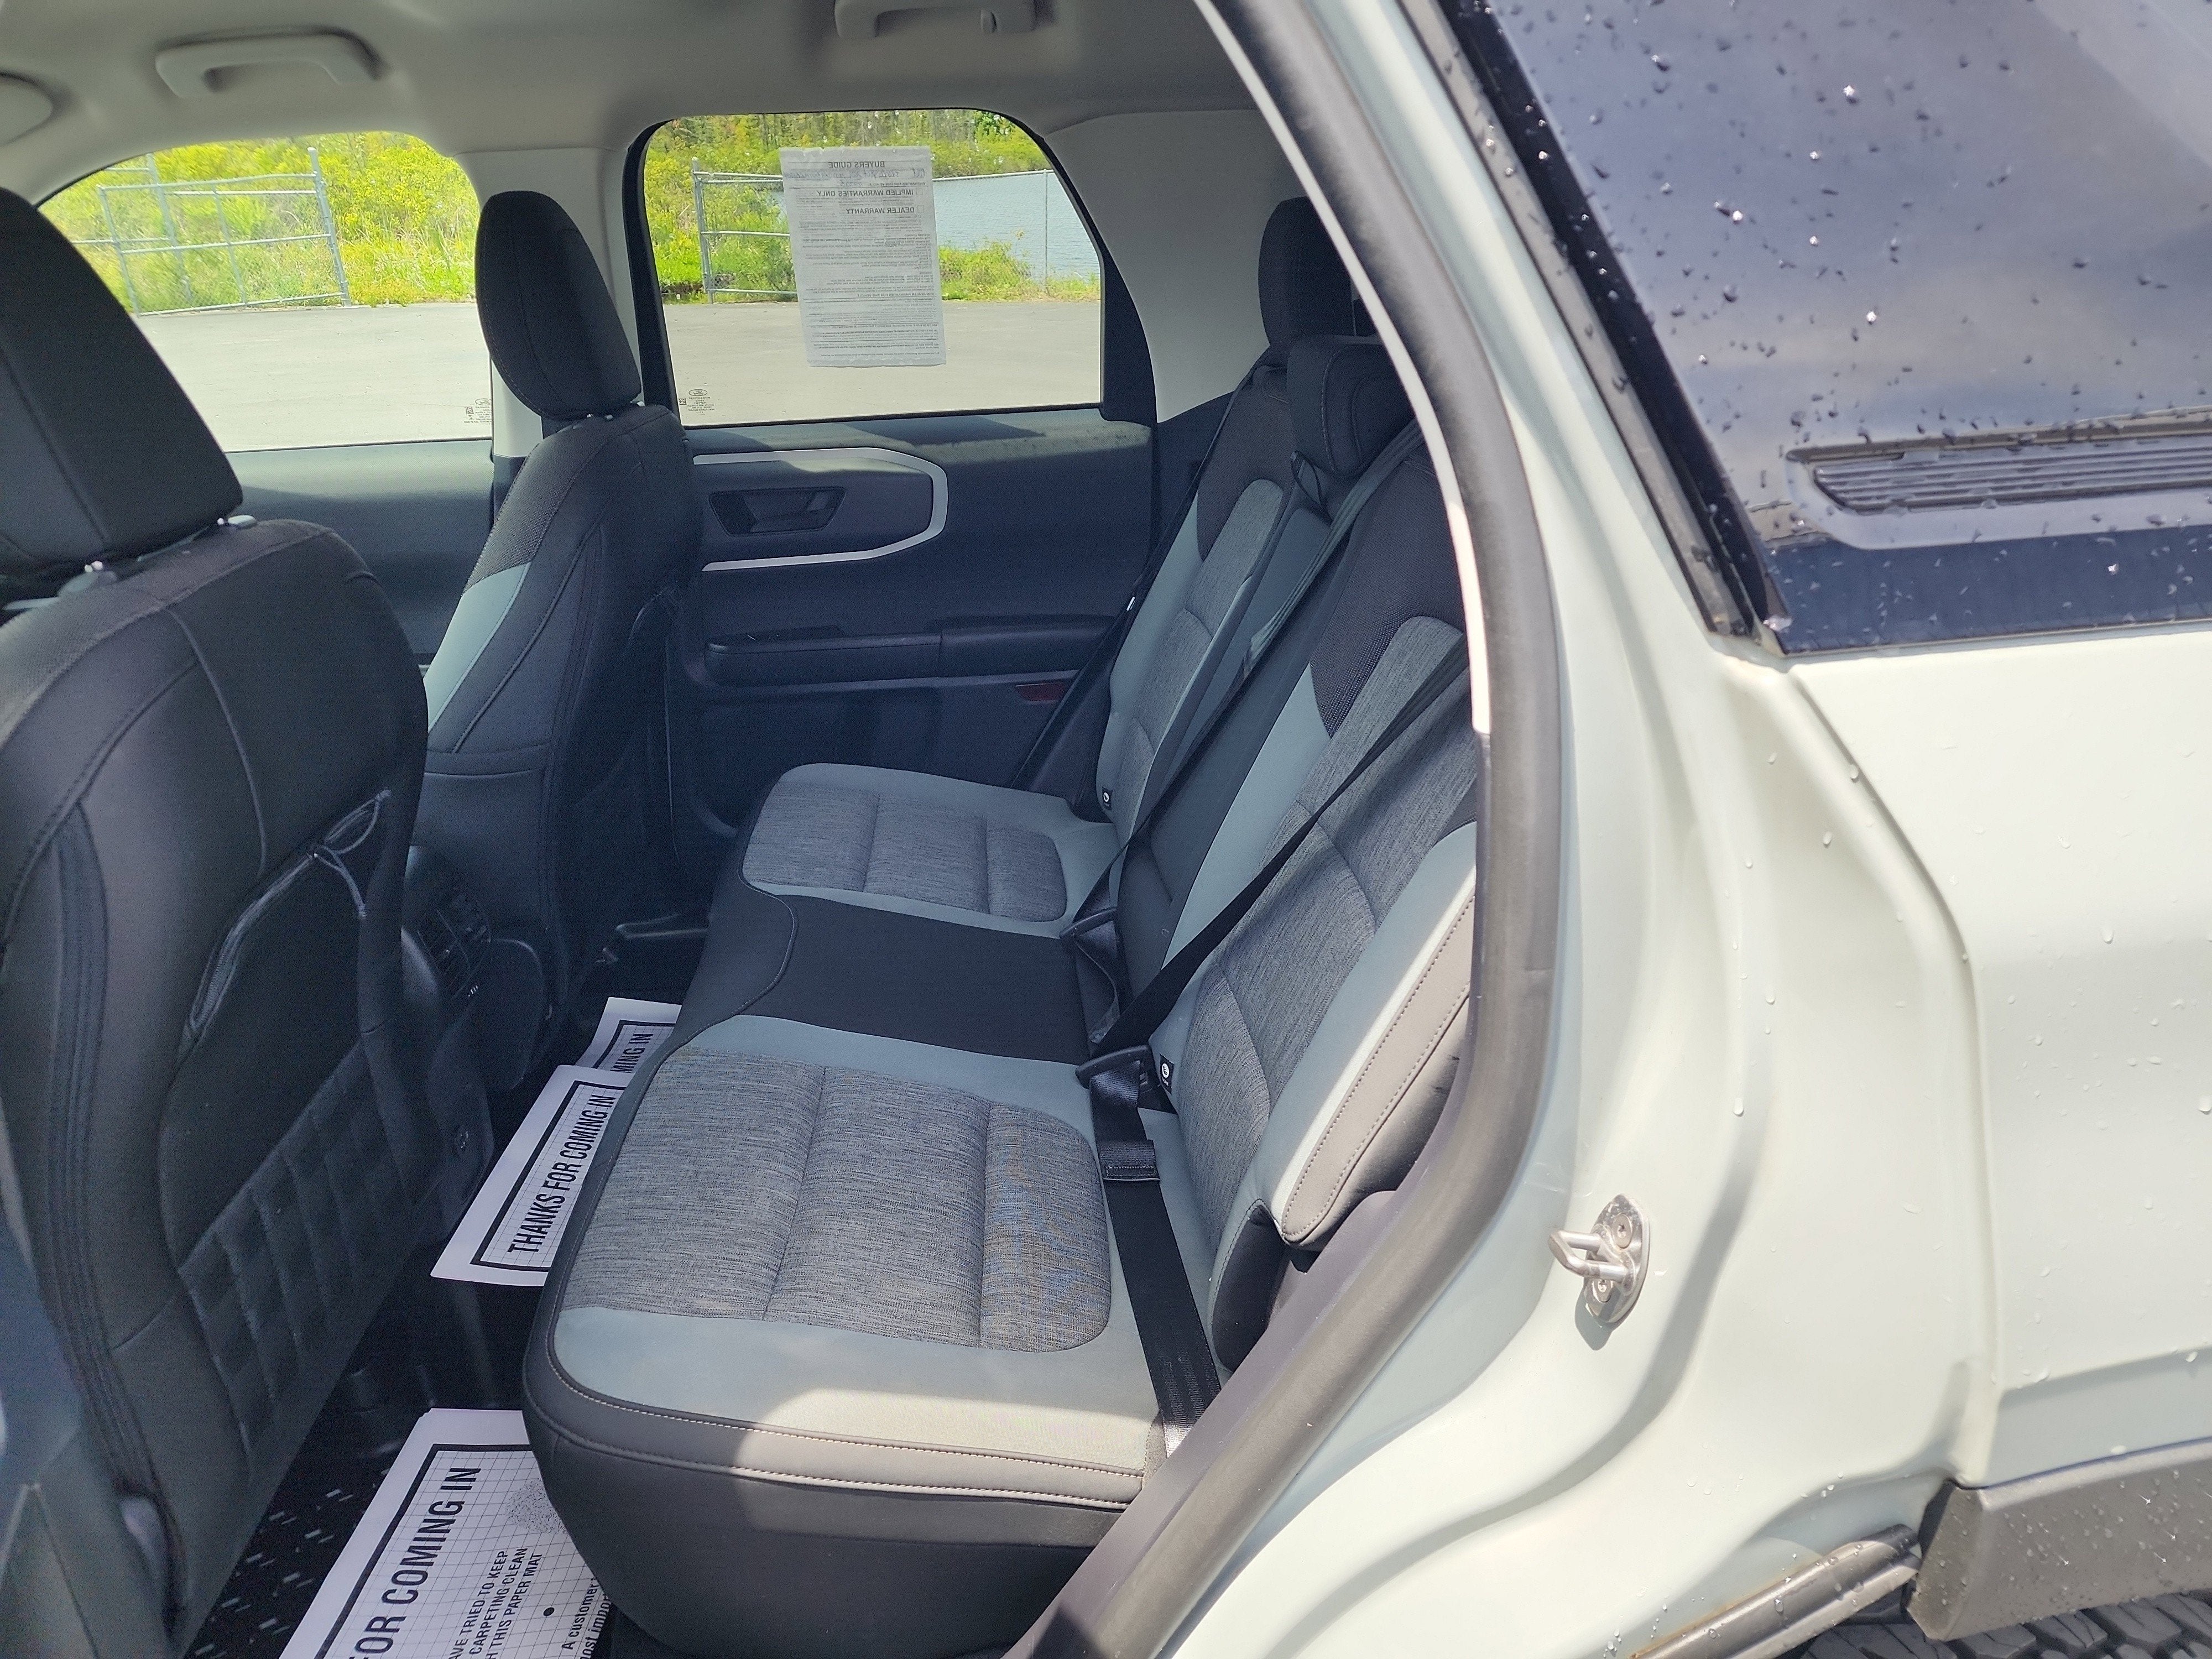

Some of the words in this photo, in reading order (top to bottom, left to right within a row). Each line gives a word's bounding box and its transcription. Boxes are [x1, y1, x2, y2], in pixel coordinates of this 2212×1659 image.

[628, 1034, 654, 1044] IN
[587, 1094, 617, 1108] IN
[559, 1109, 609, 1160] COMING
[541, 1162, 582, 1191] FOR
[508, 1193, 566, 1253] THANKS
[348, 1616, 407, 1659] OR
[381, 1500, 466, 1604] COMING
[440, 1467, 482, 1490] IN
[460, 1600, 486, 1636] TRIED
[477, 1582, 495, 1597] TO
[487, 1550, 509, 1579] KEEP
[469, 1588, 510, 1655] CARPETING
[502, 1548, 528, 1585] CLEAN
[489, 1619, 512, 1650] THIS
[504, 1580, 532, 1616] PAPER
[522, 1553, 542, 1577] MAT
[561, 1641, 576, 1650] A
[569, 1584, 599, 1637] customer
[587, 1594, 612, 1632] impor
